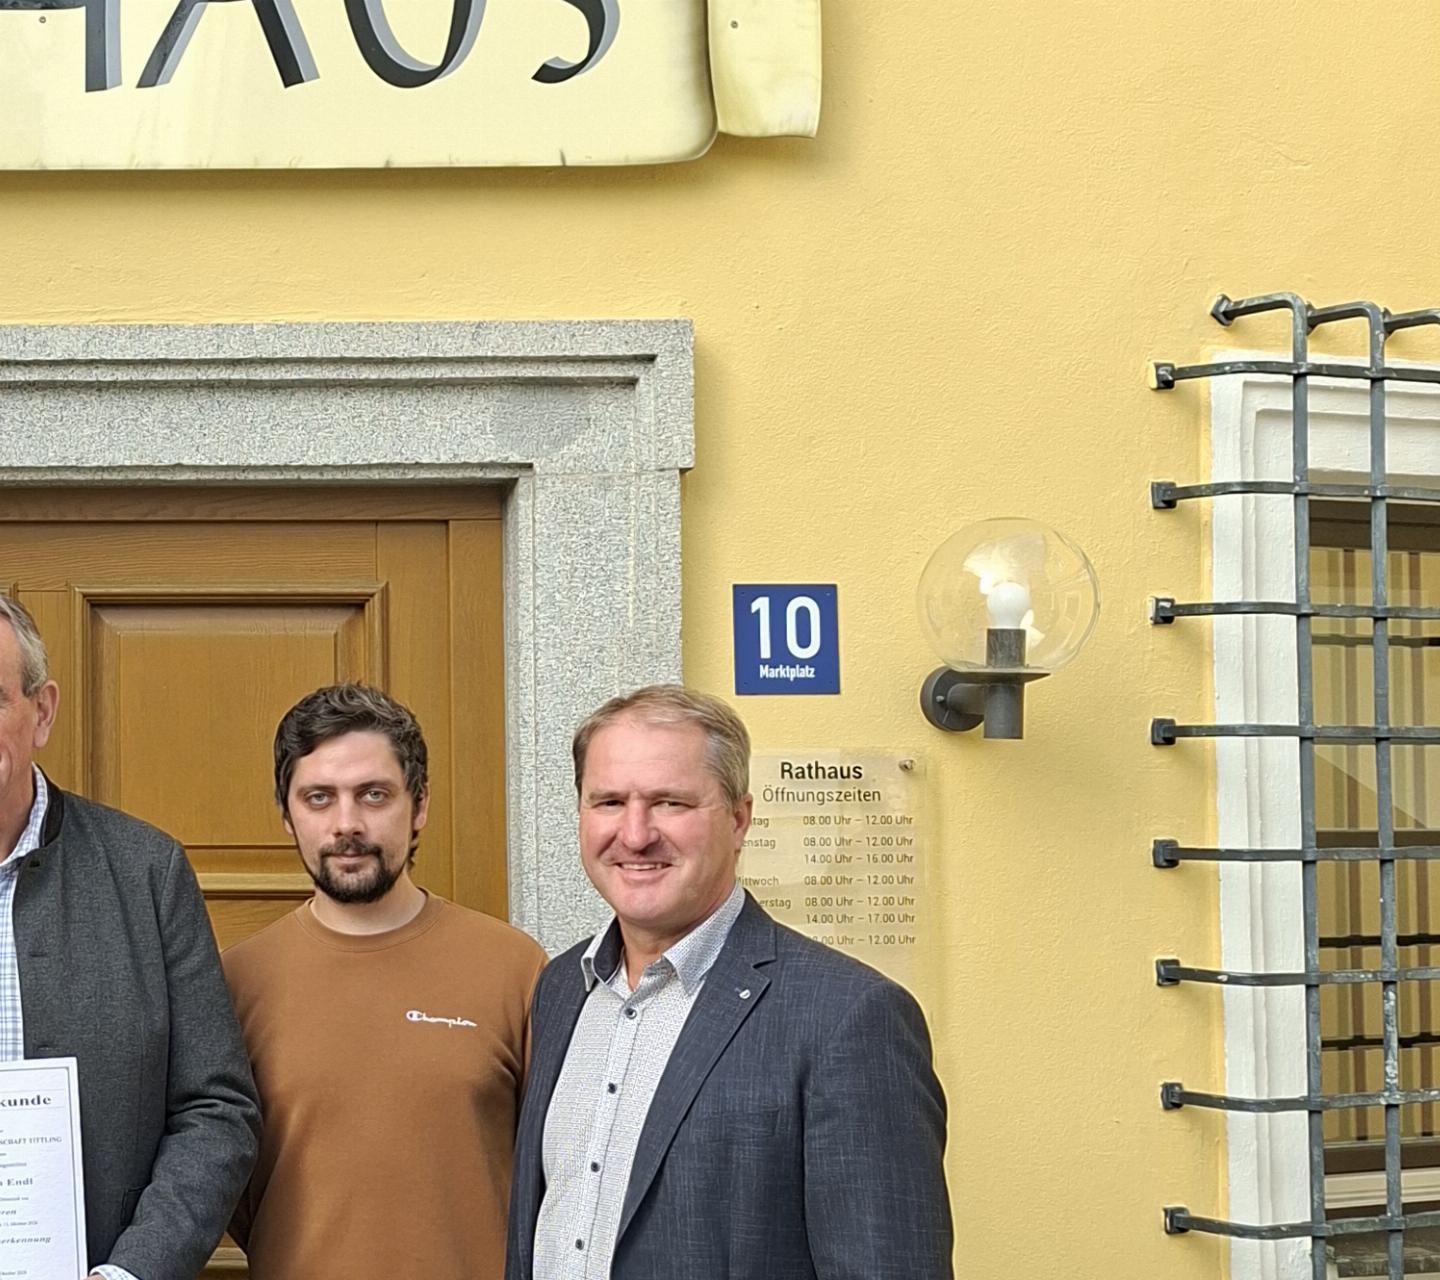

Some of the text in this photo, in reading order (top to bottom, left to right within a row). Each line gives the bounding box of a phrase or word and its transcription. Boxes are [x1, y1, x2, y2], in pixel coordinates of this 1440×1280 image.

[750, 595, 821, 659] 10
[759, 664, 816, 682] Marktplatz
[780, 761, 863, 780] Rathaus
[762, 785, 881, 806] Öffnungszeiten
[802, 815, 831, 825] 08.00
[834, 815, 851, 825] Uhr
[865, 815, 892, 825] 12.00
[895, 814, 913, 824] Uhr
[742, 838, 776, 849] enstag
[803, 837, 831, 846] 08.00
[834, 836, 852, 846] Uhr
[866, 836, 893, 846] 12.00
[896, 836, 913, 846] Uhr
[804, 854, 832, 864] 14.00
[835, 853, 852, 863] Uhr
[866, 853, 893, 863] 16.00
[896, 853, 914, 863] Uhr
[804, 876, 832, 885] 08.00
[835, 875, 853, 885] Uhr
[867, 875, 894, 885] 12.00
[897, 875, 914, 884] Uhr
[805, 897, 833, 907] 08.00
[836, 896, 854, 906] Uhr
[867, 896, 894, 906] 12.00
[897, 896, 915, 906] Uhr
[806, 914, 833, 924] 14.00
[836, 913, 854, 923] Uhr
[868, 913, 895, 923] 17.00
[898, 913, 915, 923] Uhr
[837, 935, 854, 945] Uhr
[868, 935, 895, 945] 12.00
[898, 934, 916, 944] Uhr
[7, 1177, 34, 1188] Endl
